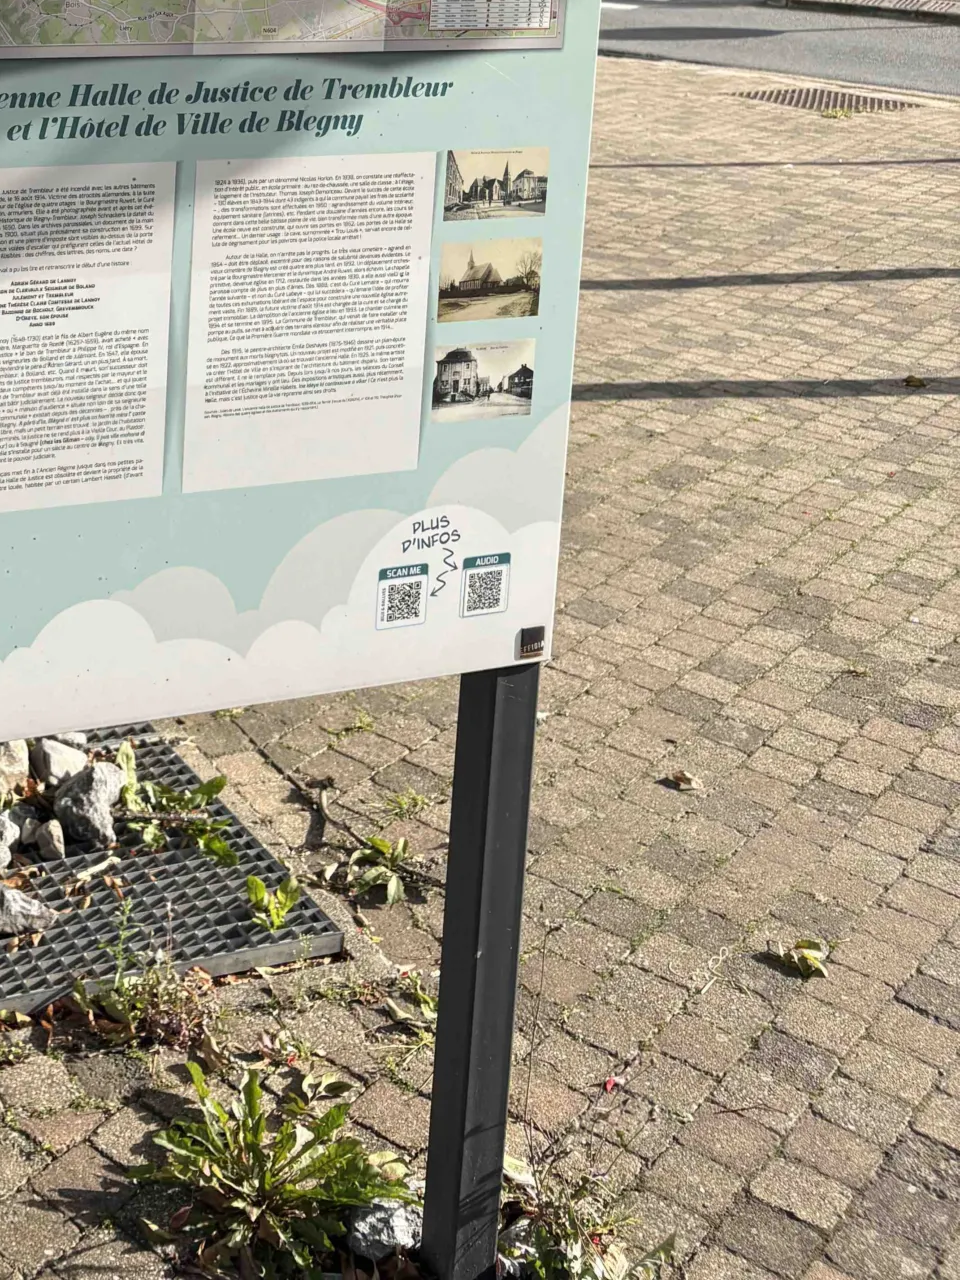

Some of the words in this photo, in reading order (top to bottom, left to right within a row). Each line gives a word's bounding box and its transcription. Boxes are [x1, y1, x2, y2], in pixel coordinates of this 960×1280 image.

[65, 1, 81, 9] Bois
[262, 27, 277, 35] N604
[67, 83, 141, 109] Halle
[148, 82, 179, 106] de
[184, 79, 279, 107] Justice
[284, 78, 316, 102] de
[322, 76, 454, 101] Trembleur
[7, 118, 32, 141] et
[38, 113, 130, 140] l'Hôtel
[135, 112, 167, 138] de
[175, 110, 233, 135] Ville
[238, 108, 269, 134] de
[275, 109, 364, 138] Blegny
[1, 188, 19, 196] Justice
[412, 515, 450, 534] PLUS
[401, 529, 461, 553] D'INFOS
[475, 555, 499, 566] AUDIO
[386, 567, 408, 578] SCAN
[409, 565, 422, 576] ME
